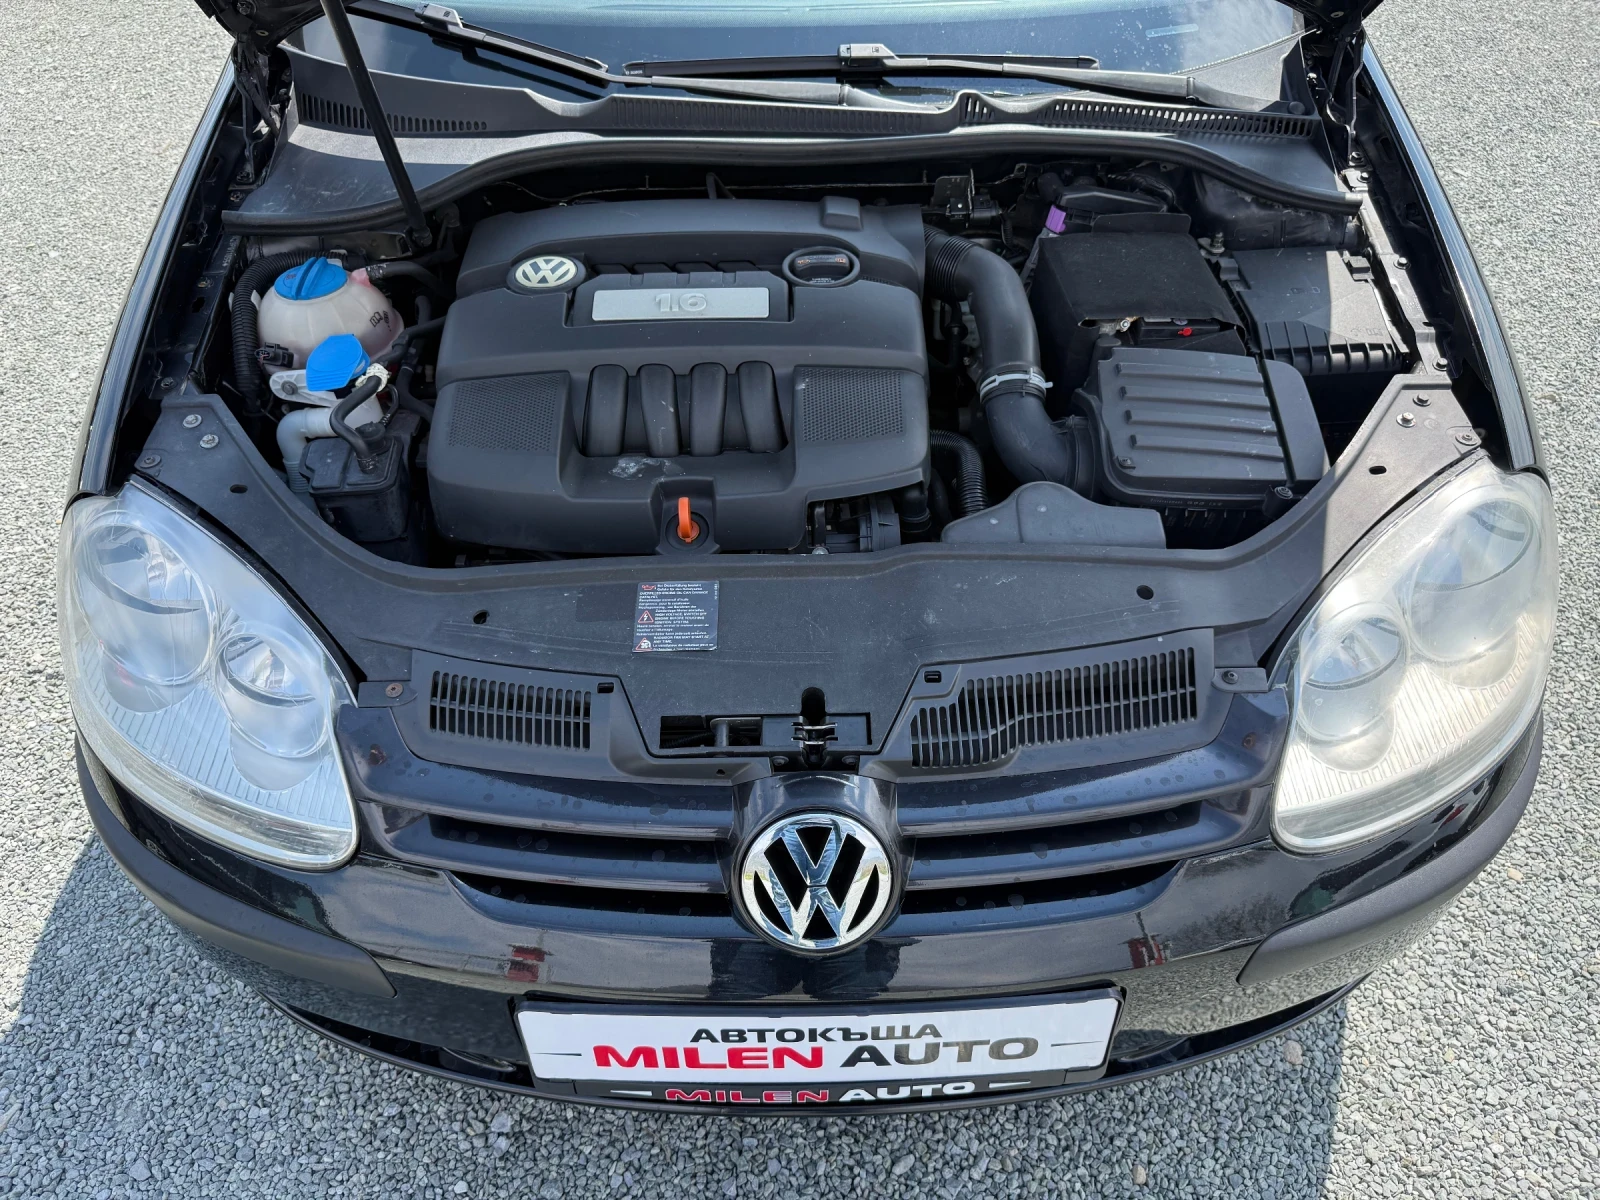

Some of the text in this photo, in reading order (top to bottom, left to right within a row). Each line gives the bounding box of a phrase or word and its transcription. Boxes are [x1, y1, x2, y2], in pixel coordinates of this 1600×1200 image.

[655, 292, 708, 312] 1.6
[690, 1023, 942, 1043] АВТОКЪША
[593, 1037, 1039, 1069] MILEN AUTO
[665, 1081, 975, 1103] MILEN AUTO
